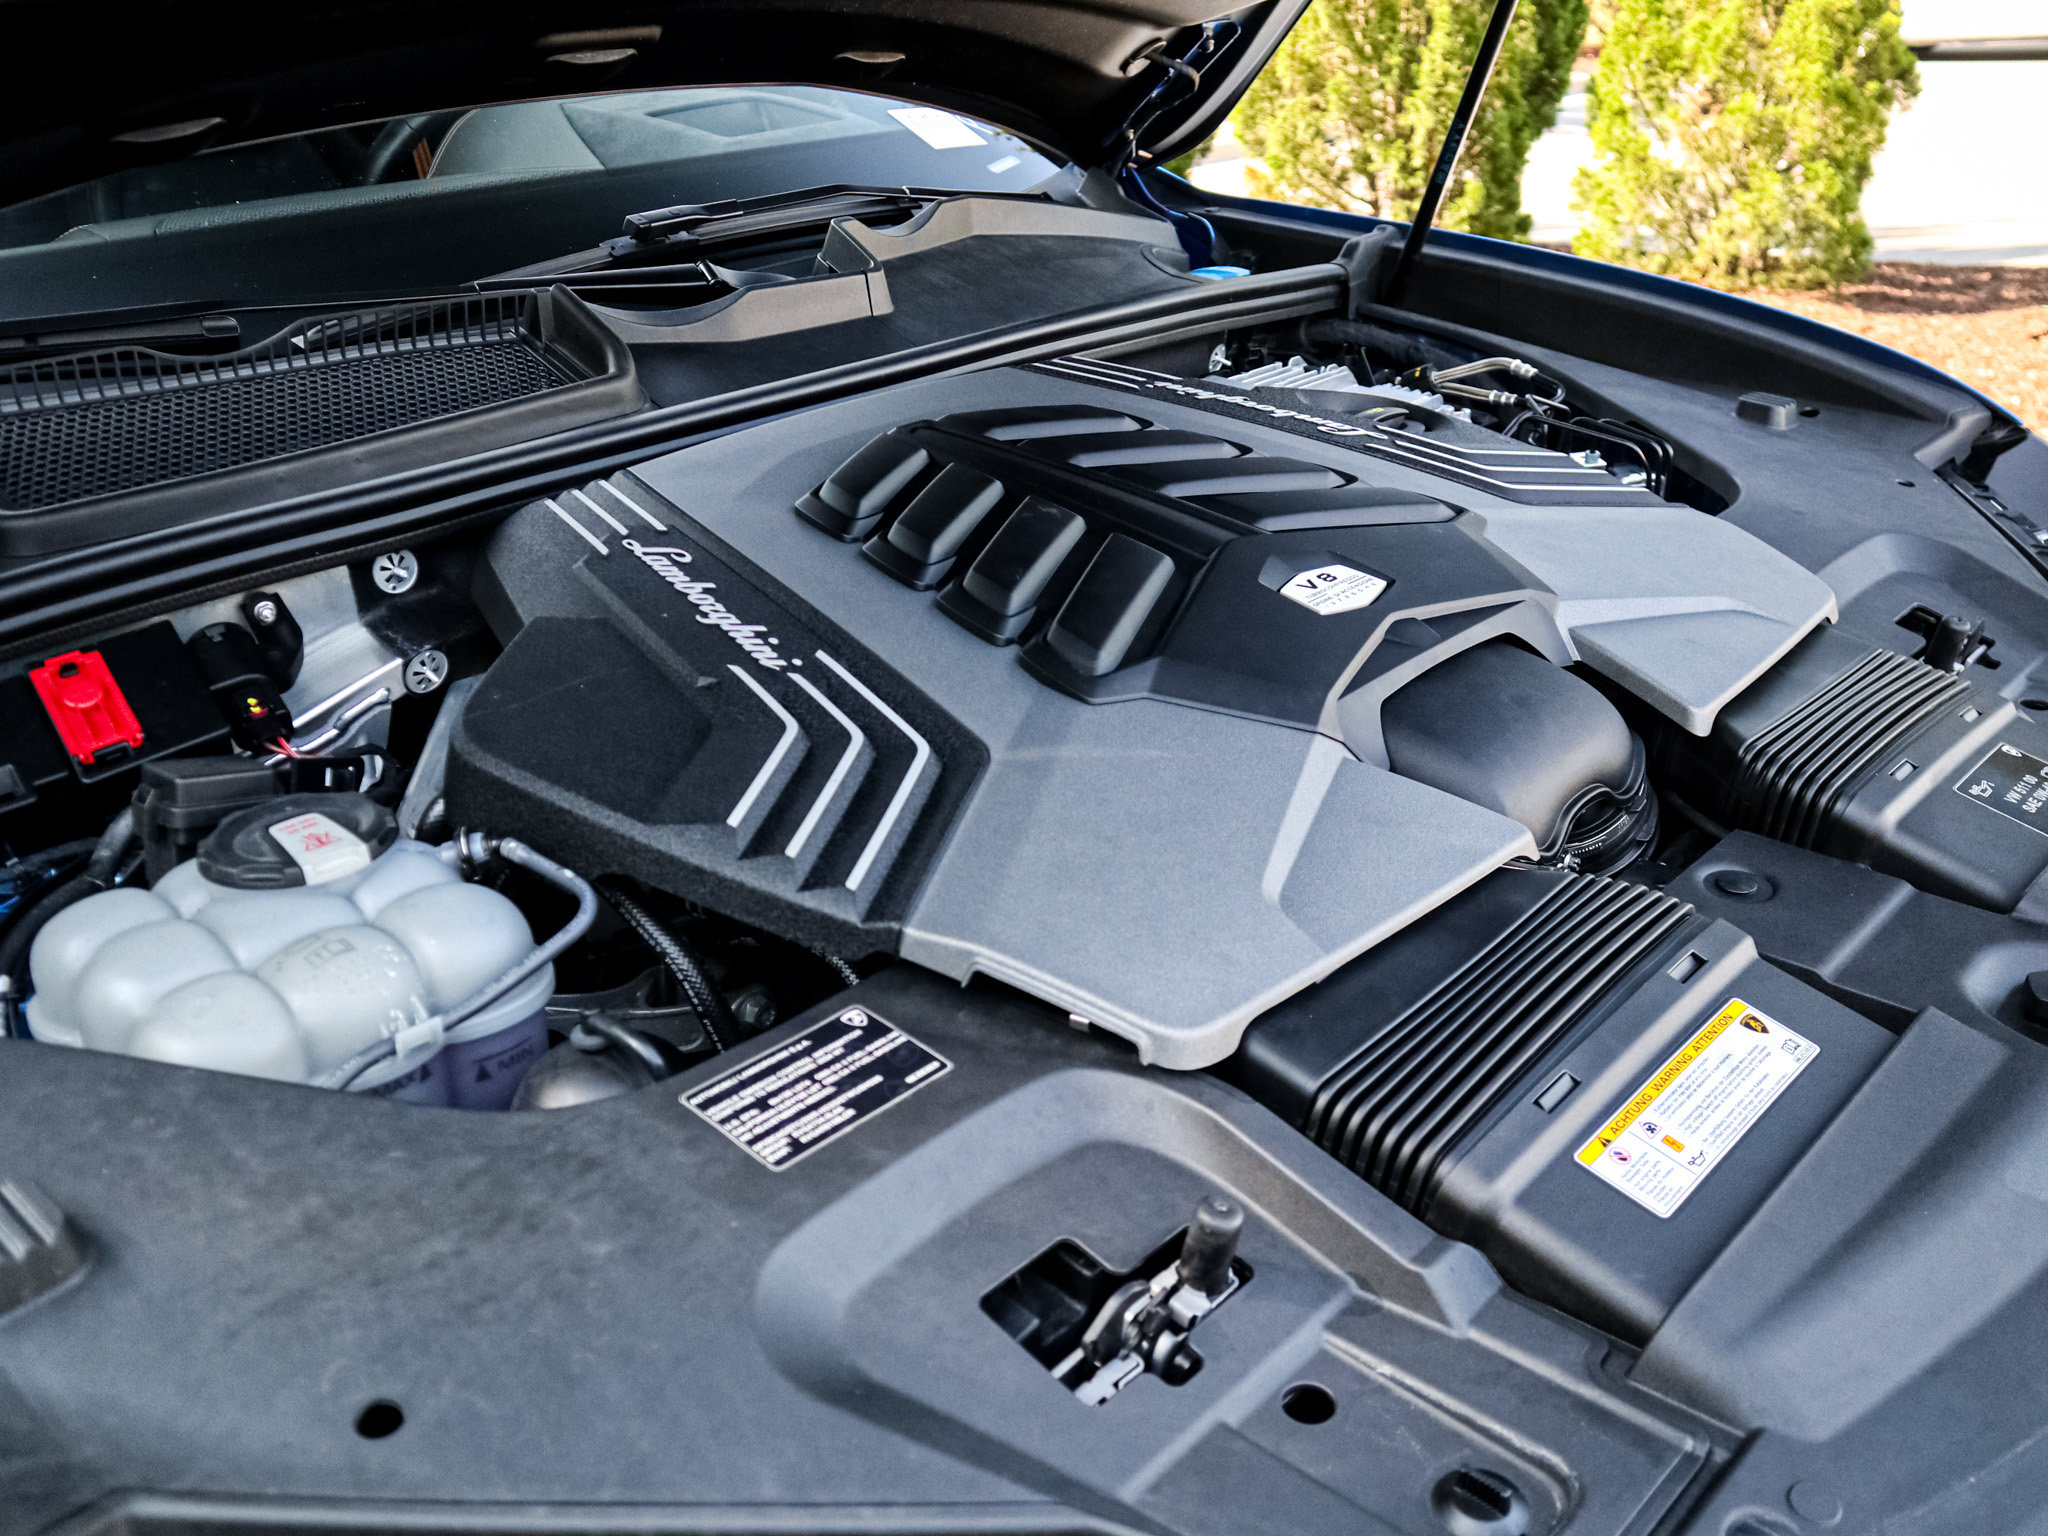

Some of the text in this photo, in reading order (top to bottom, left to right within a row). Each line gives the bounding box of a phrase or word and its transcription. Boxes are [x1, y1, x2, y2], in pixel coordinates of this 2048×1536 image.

[1146, 381, 1389, 440] Lamborghini
[621, 538, 803, 671] Lamborghini
[2022, 797, 2043, 813] SAE
[1609, 1092, 1653, 1135] ACHTUNG
[1651, 1052, 1693, 1092] WARNING
[1691, 1013, 1734, 1052] ATTENTION
